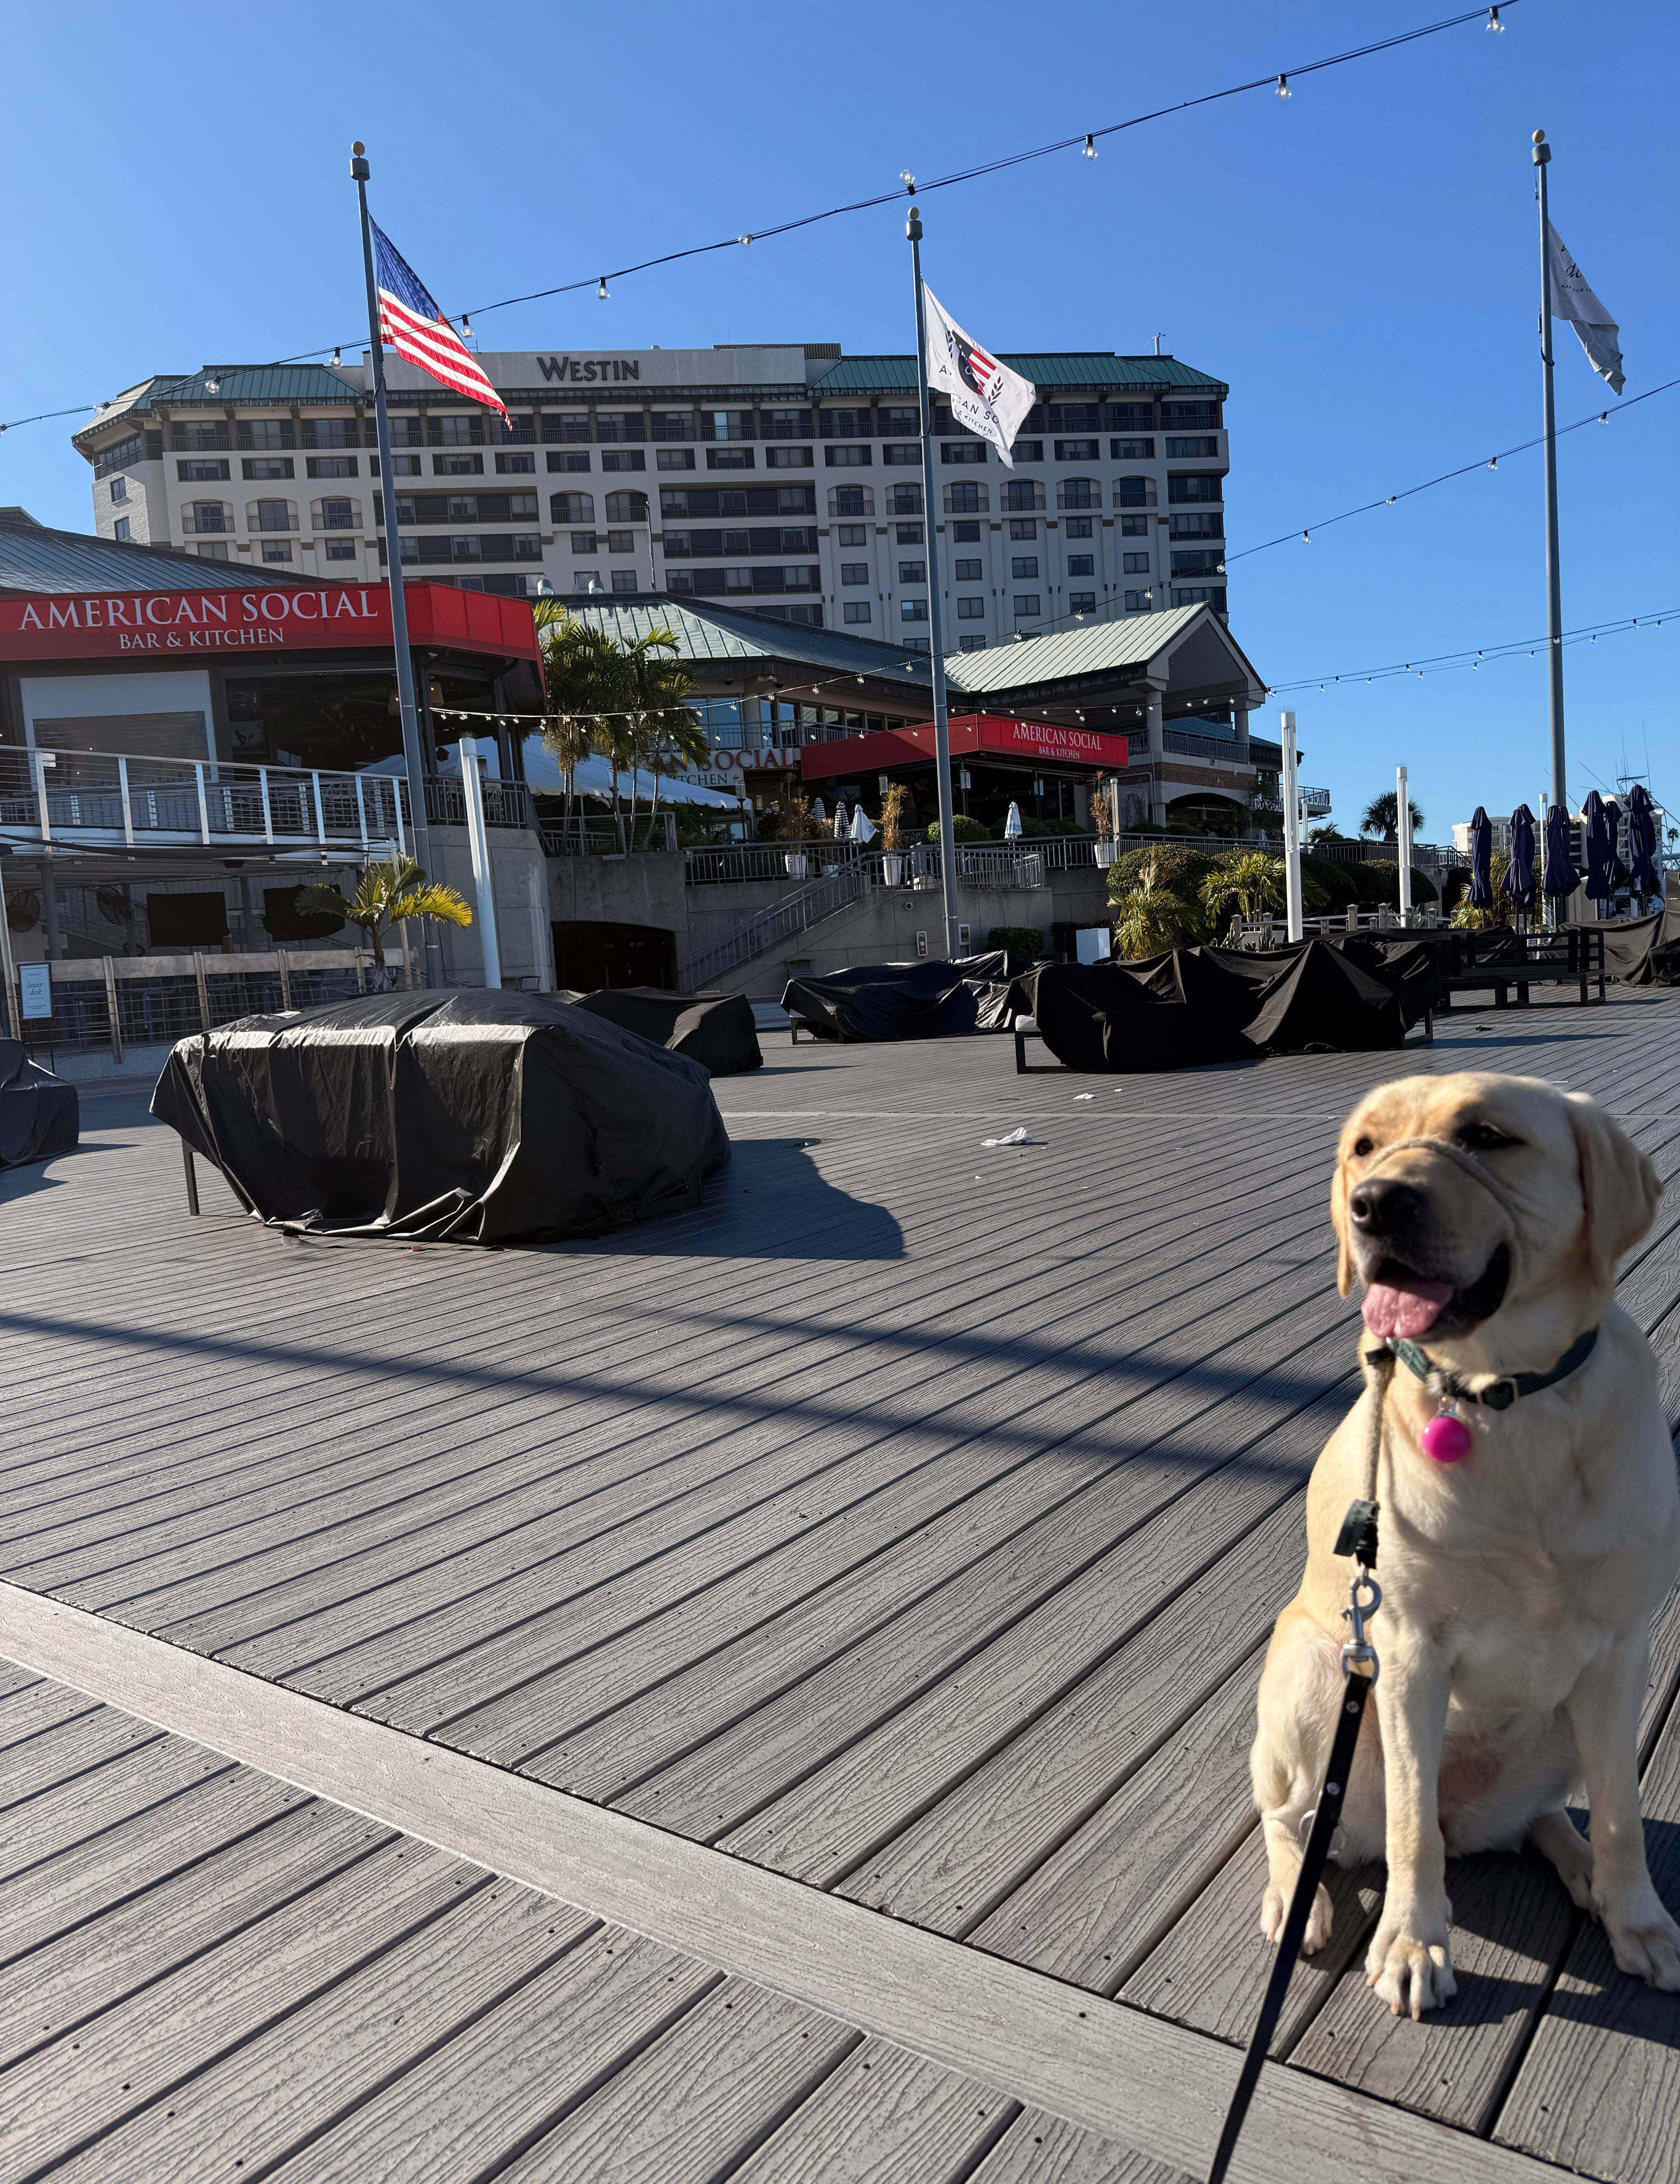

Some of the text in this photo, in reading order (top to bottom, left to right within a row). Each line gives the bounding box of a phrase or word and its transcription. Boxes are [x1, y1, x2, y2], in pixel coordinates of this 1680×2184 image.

[536, 357, 639, 382] WESTIN
[964, 415, 993, 434] KITCHEN
[18, 590, 378, 630] AMERICAN SOCIAL
[120, 627, 284, 649] BAR & KITCHEN
[1013, 723, 1102, 750] AMERICAN SOCIAL
[1039, 745, 1080, 759] BAR & KITCHEN
[677, 773, 728, 785] TCHEN
